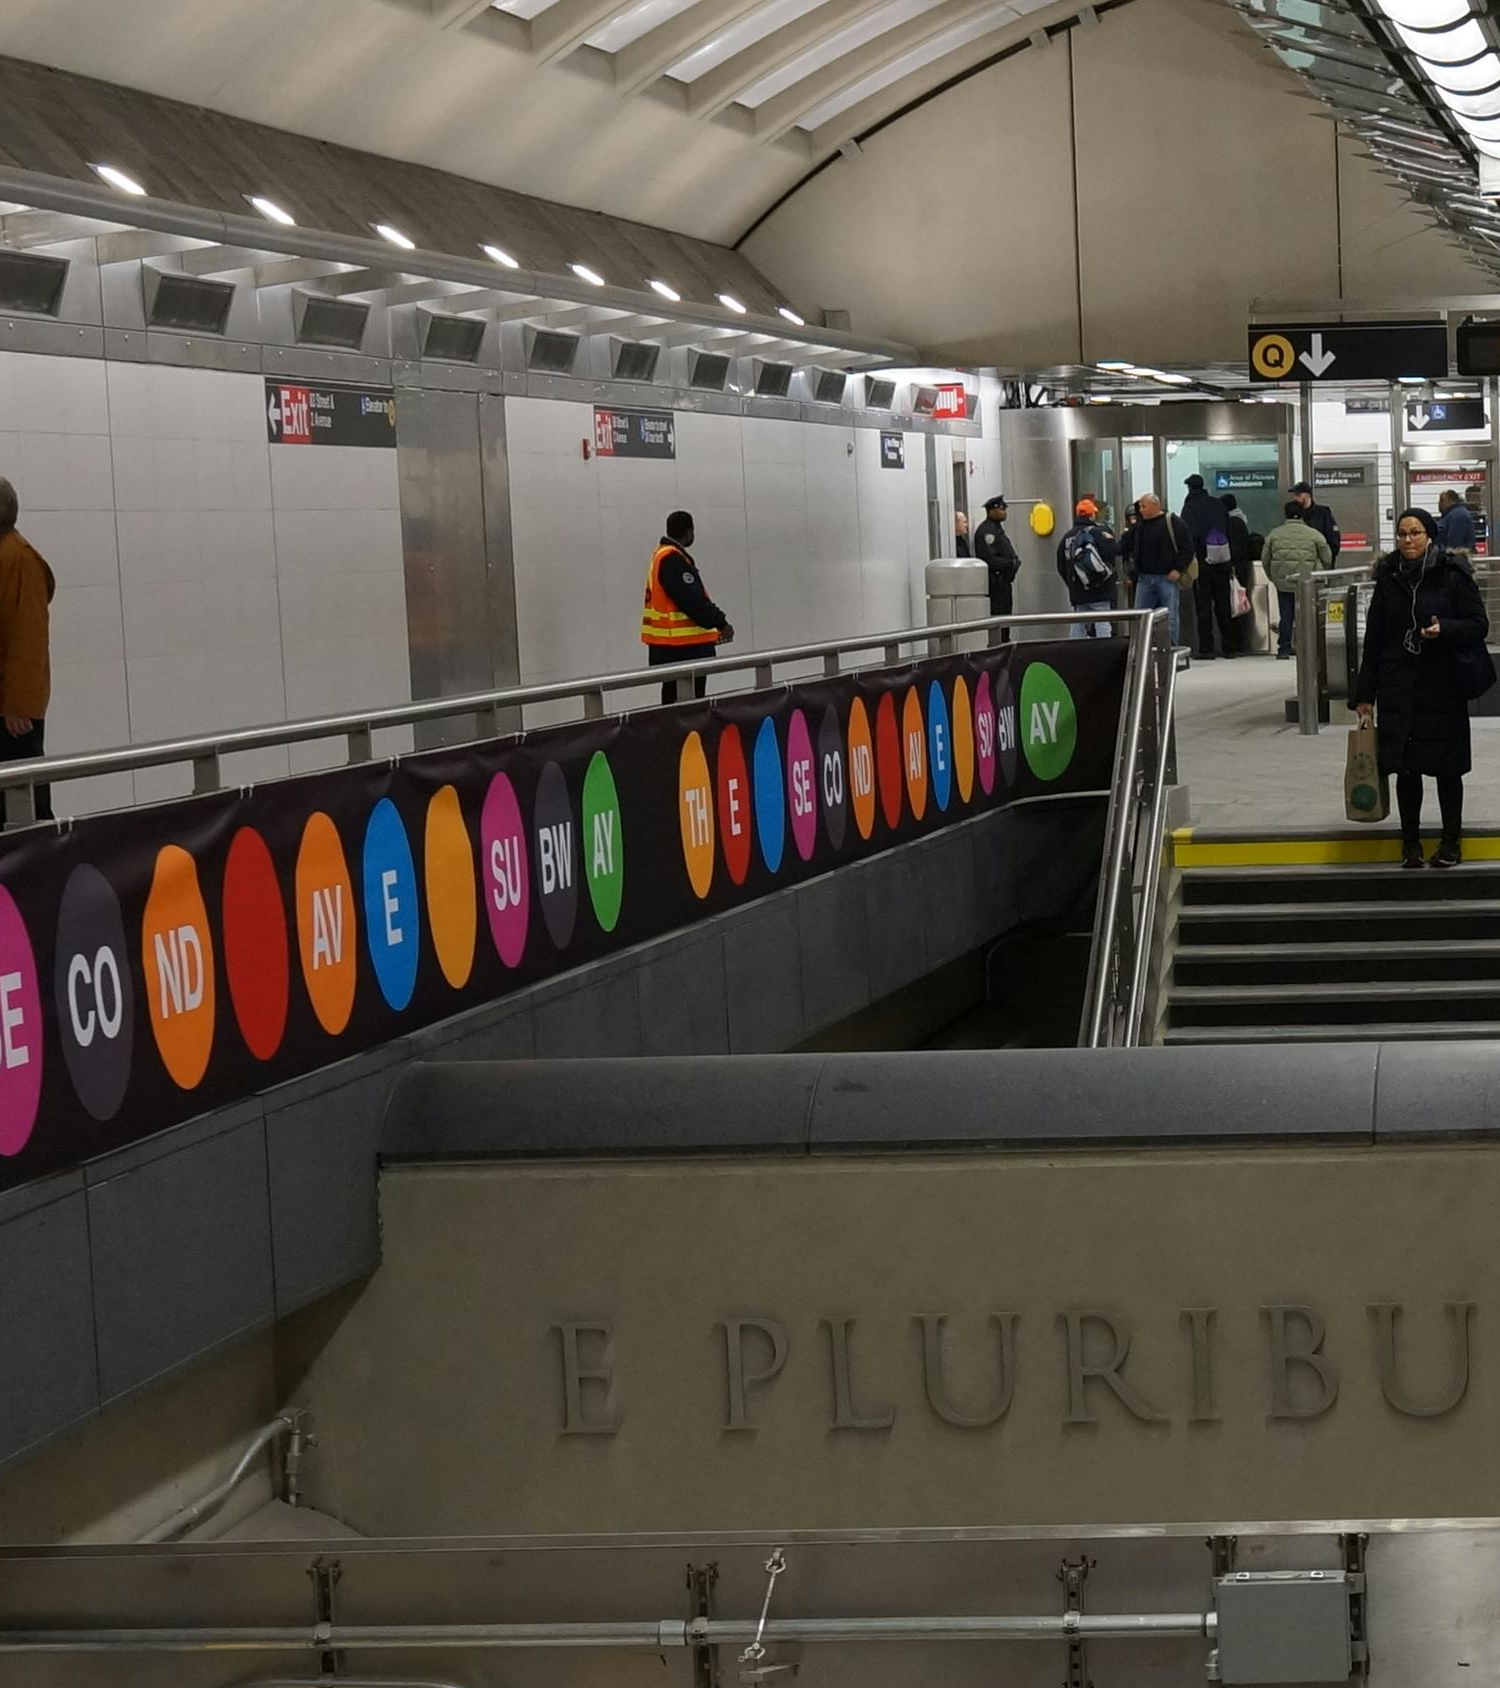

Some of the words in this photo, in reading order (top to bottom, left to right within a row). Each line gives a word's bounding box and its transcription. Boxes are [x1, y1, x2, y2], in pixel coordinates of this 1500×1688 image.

[1262, 343, 1285, 368] Q
[280, 389, 309, 436] Exit
[595, 413, 613, 450] Exit
[1416, 472, 1463, 481] EMERGENCY
[1464, 472, 1481, 481] EXIT
[685, 787, 709, 848] TH
[729, 778, 741, 836] E
[792, 759, 813, 817] SE
[823, 749, 844, 808] CO
[852, 744, 872, 798] ND
[909, 730, 923, 781] AV
[936, 724, 946, 771] E
[978, 711, 993, 759] SU
[999, 704, 1015, 751] BW
[1029, 701, 1060, 746] AY
[67, 945, 124, 1048] CO
[153, 924, 206, 1019] ND
[312, 884, 343, 970] AV
[381, 868, 404, 946] E
[490, 835, 522, 911] SU
[538, 820, 573, 895] BW
[592, 809, 615, 879] AY
[552, 1320, 622, 1436] E
